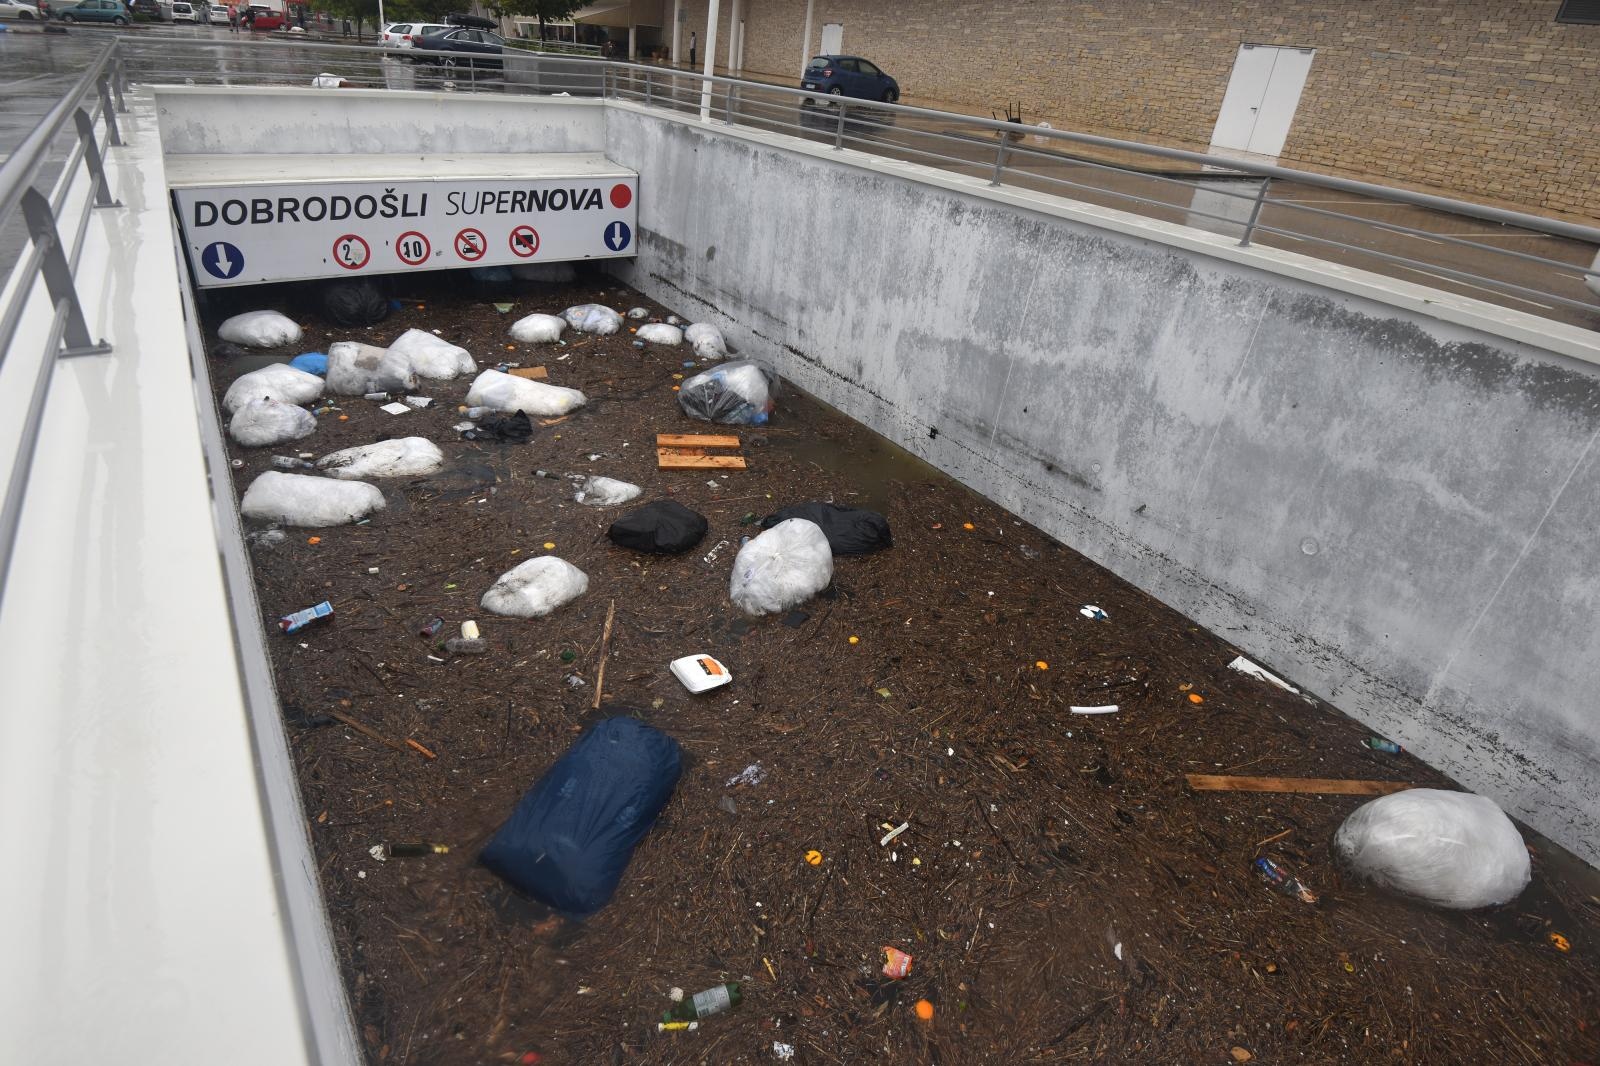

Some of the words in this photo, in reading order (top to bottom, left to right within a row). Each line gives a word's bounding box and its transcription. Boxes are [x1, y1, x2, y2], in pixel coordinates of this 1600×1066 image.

[194, 187, 428, 227] DOBRODOŠLI
[445, 188, 604, 216] SUPERNOVA
[403, 240, 422, 258] 10
